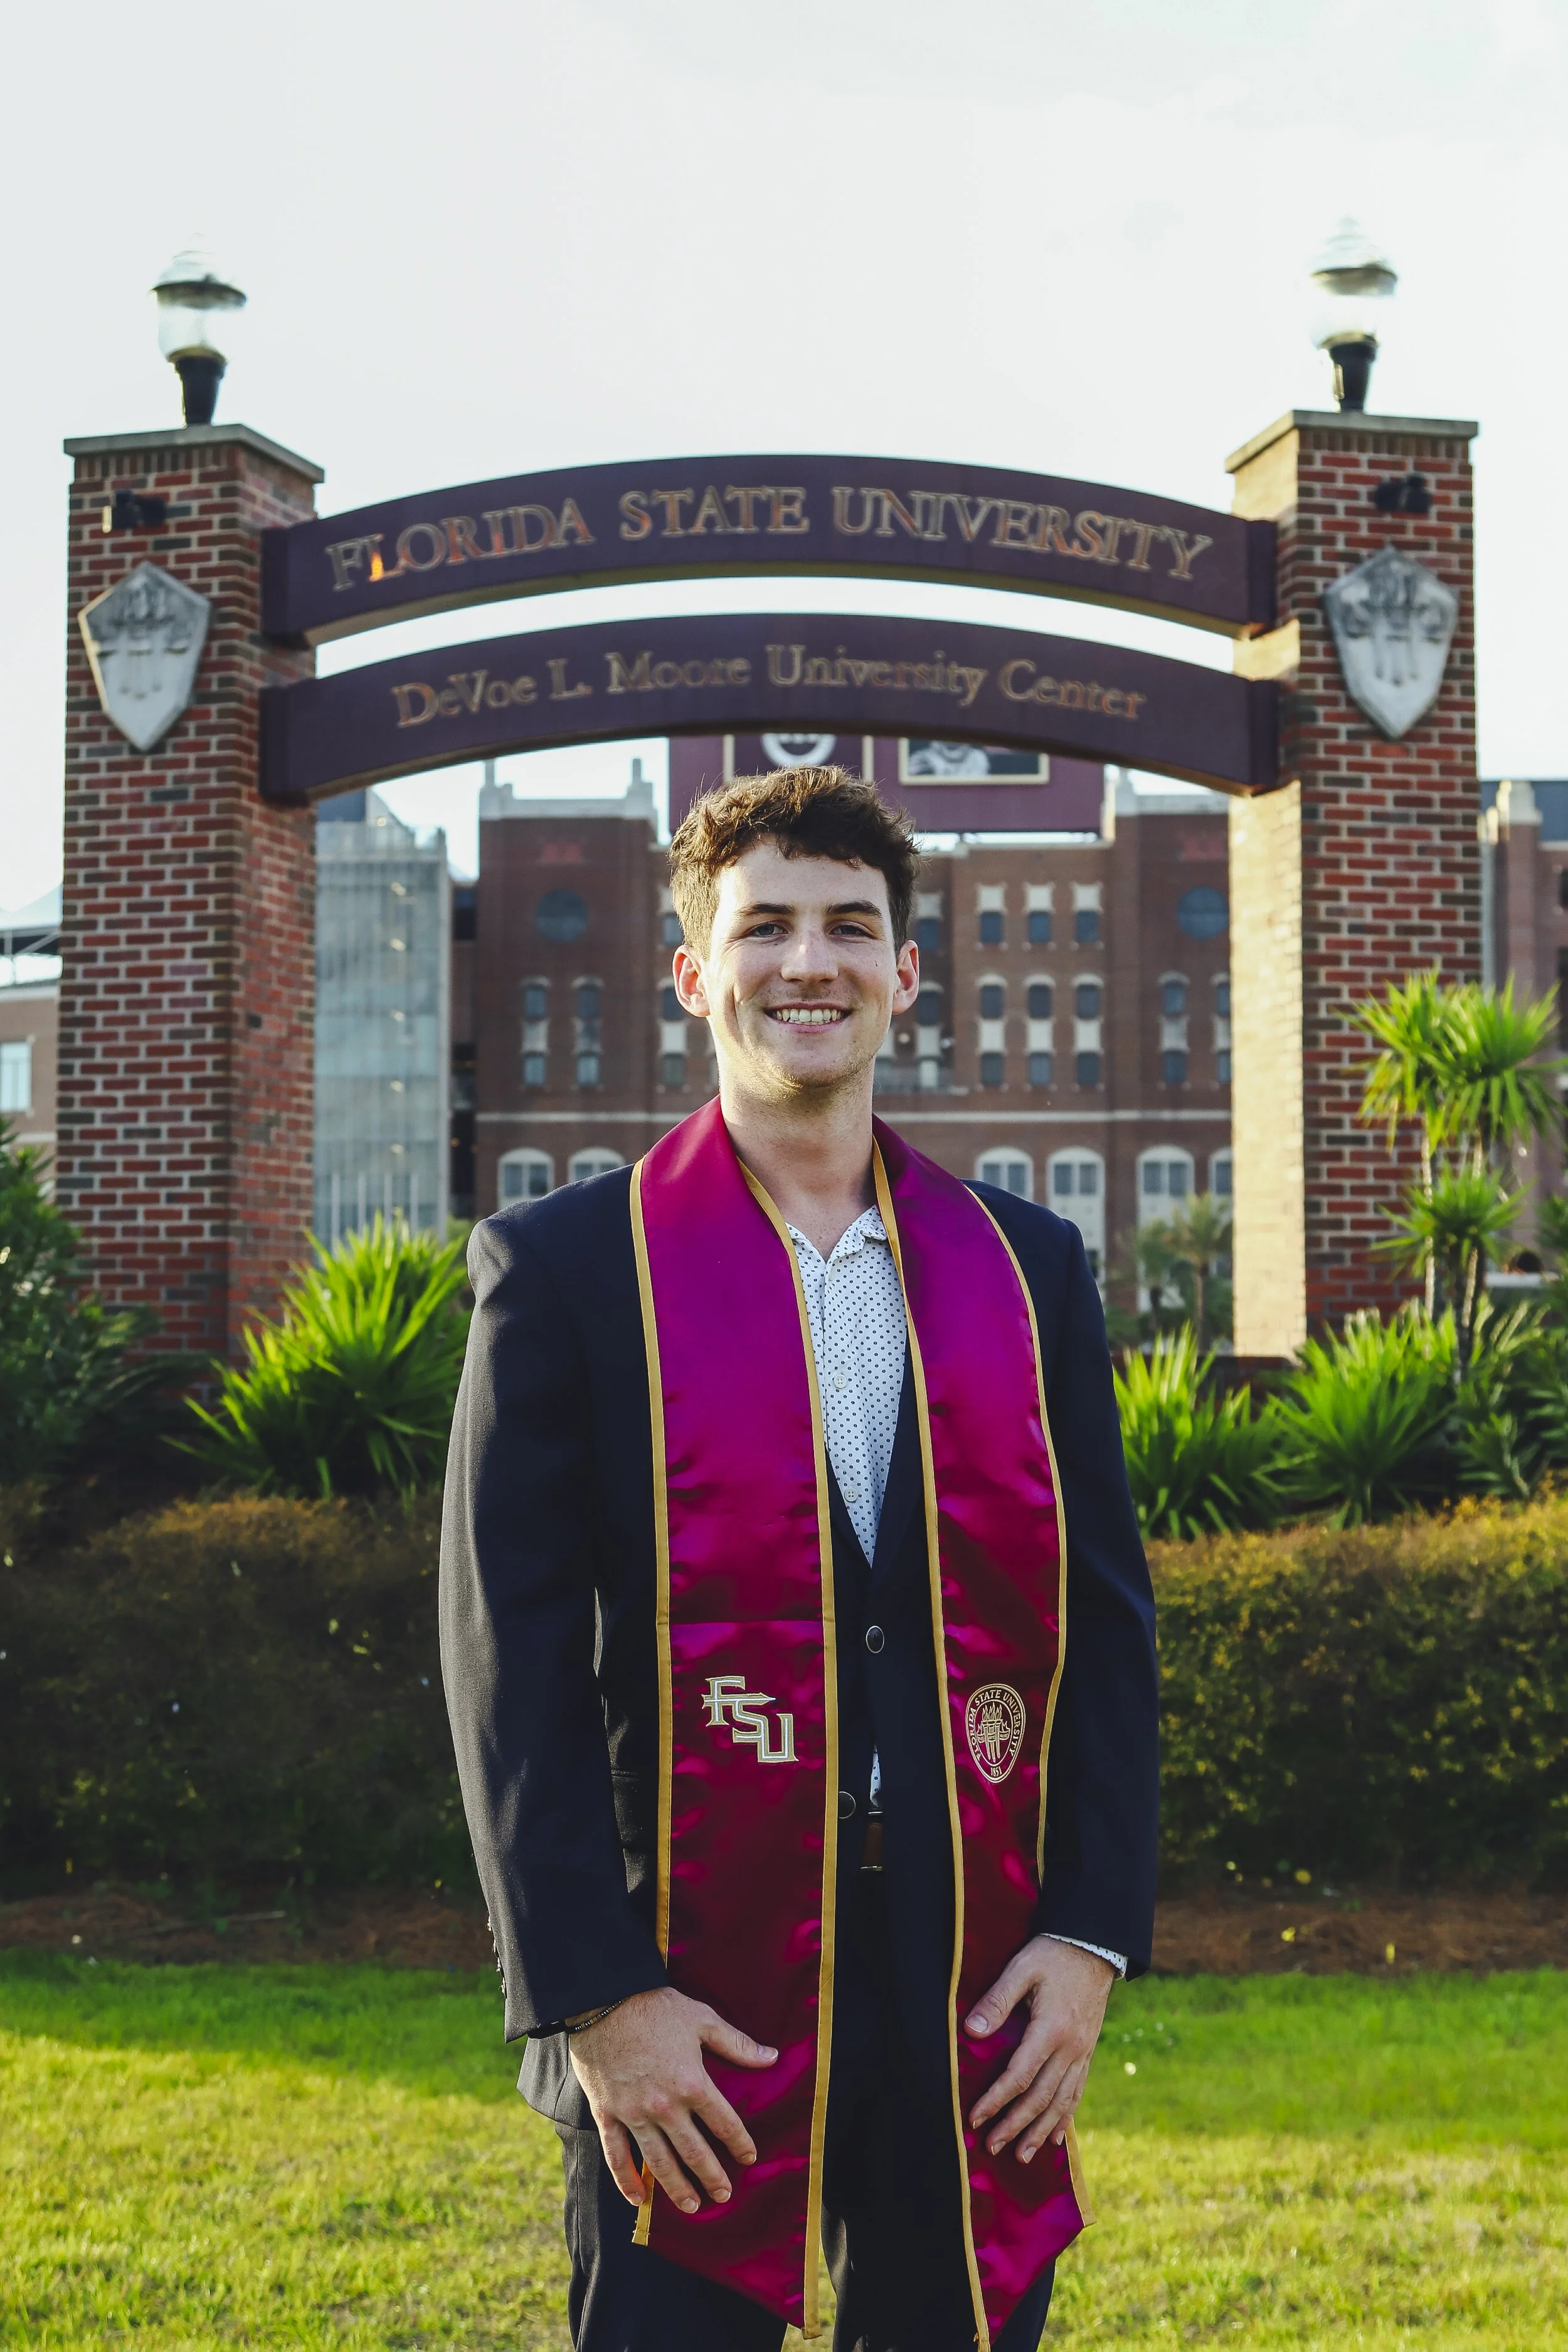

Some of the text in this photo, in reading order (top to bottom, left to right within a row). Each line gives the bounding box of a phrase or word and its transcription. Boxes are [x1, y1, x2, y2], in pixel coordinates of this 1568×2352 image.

[326, 485, 1214, 591] FLORIDA STATE UNIVERSITY
[391, 644, 1146, 728] DeVoe L. Moore University Center
[701, 1676, 799, 1762] FSU
[969, 1690, 1021, 1761] FLORIDA STATE UNIVERSITY
[990, 1766, 1002, 1777] 1851
